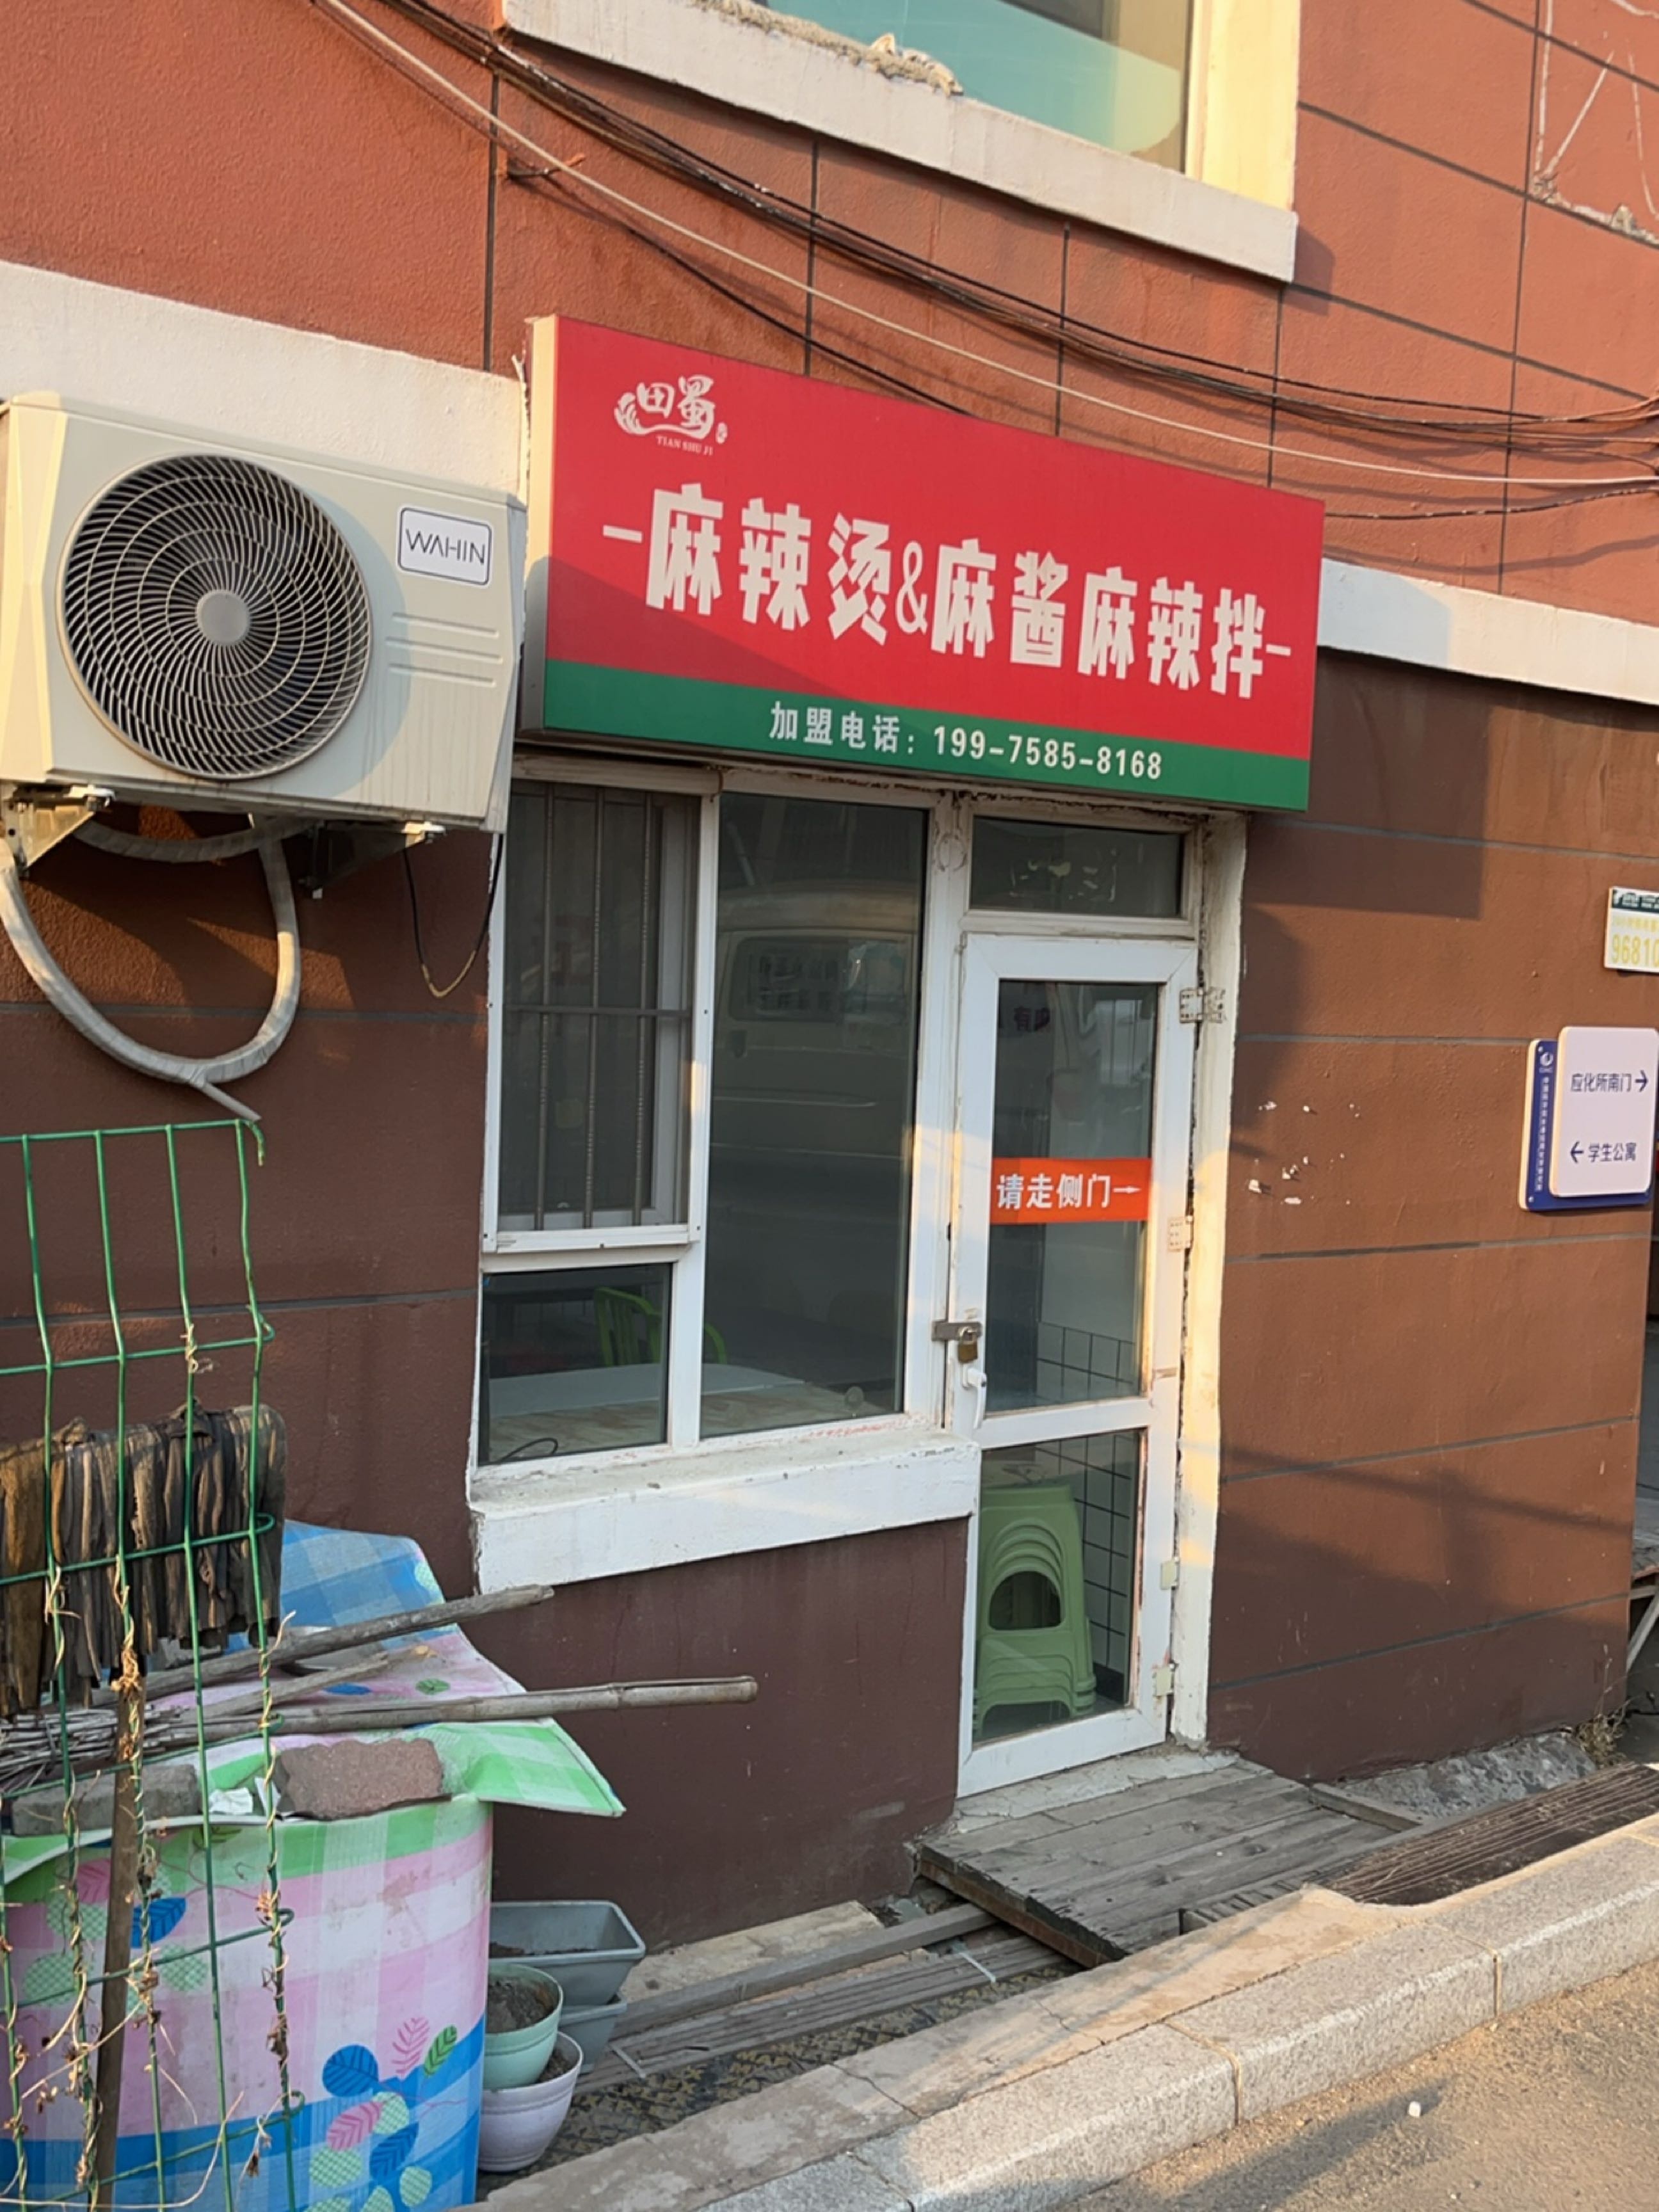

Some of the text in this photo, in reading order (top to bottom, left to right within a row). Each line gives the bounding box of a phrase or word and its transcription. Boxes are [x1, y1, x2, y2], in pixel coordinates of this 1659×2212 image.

[655, 435, 682, 449] TIAN
[405, 529, 486, 566] WAHIN
[1570, 1073, 1632, 1093] 应化所南门
[1587, 1142, 1637, 1162] 学生公寓
[996, 1173, 1111, 1209] 请走侧门
